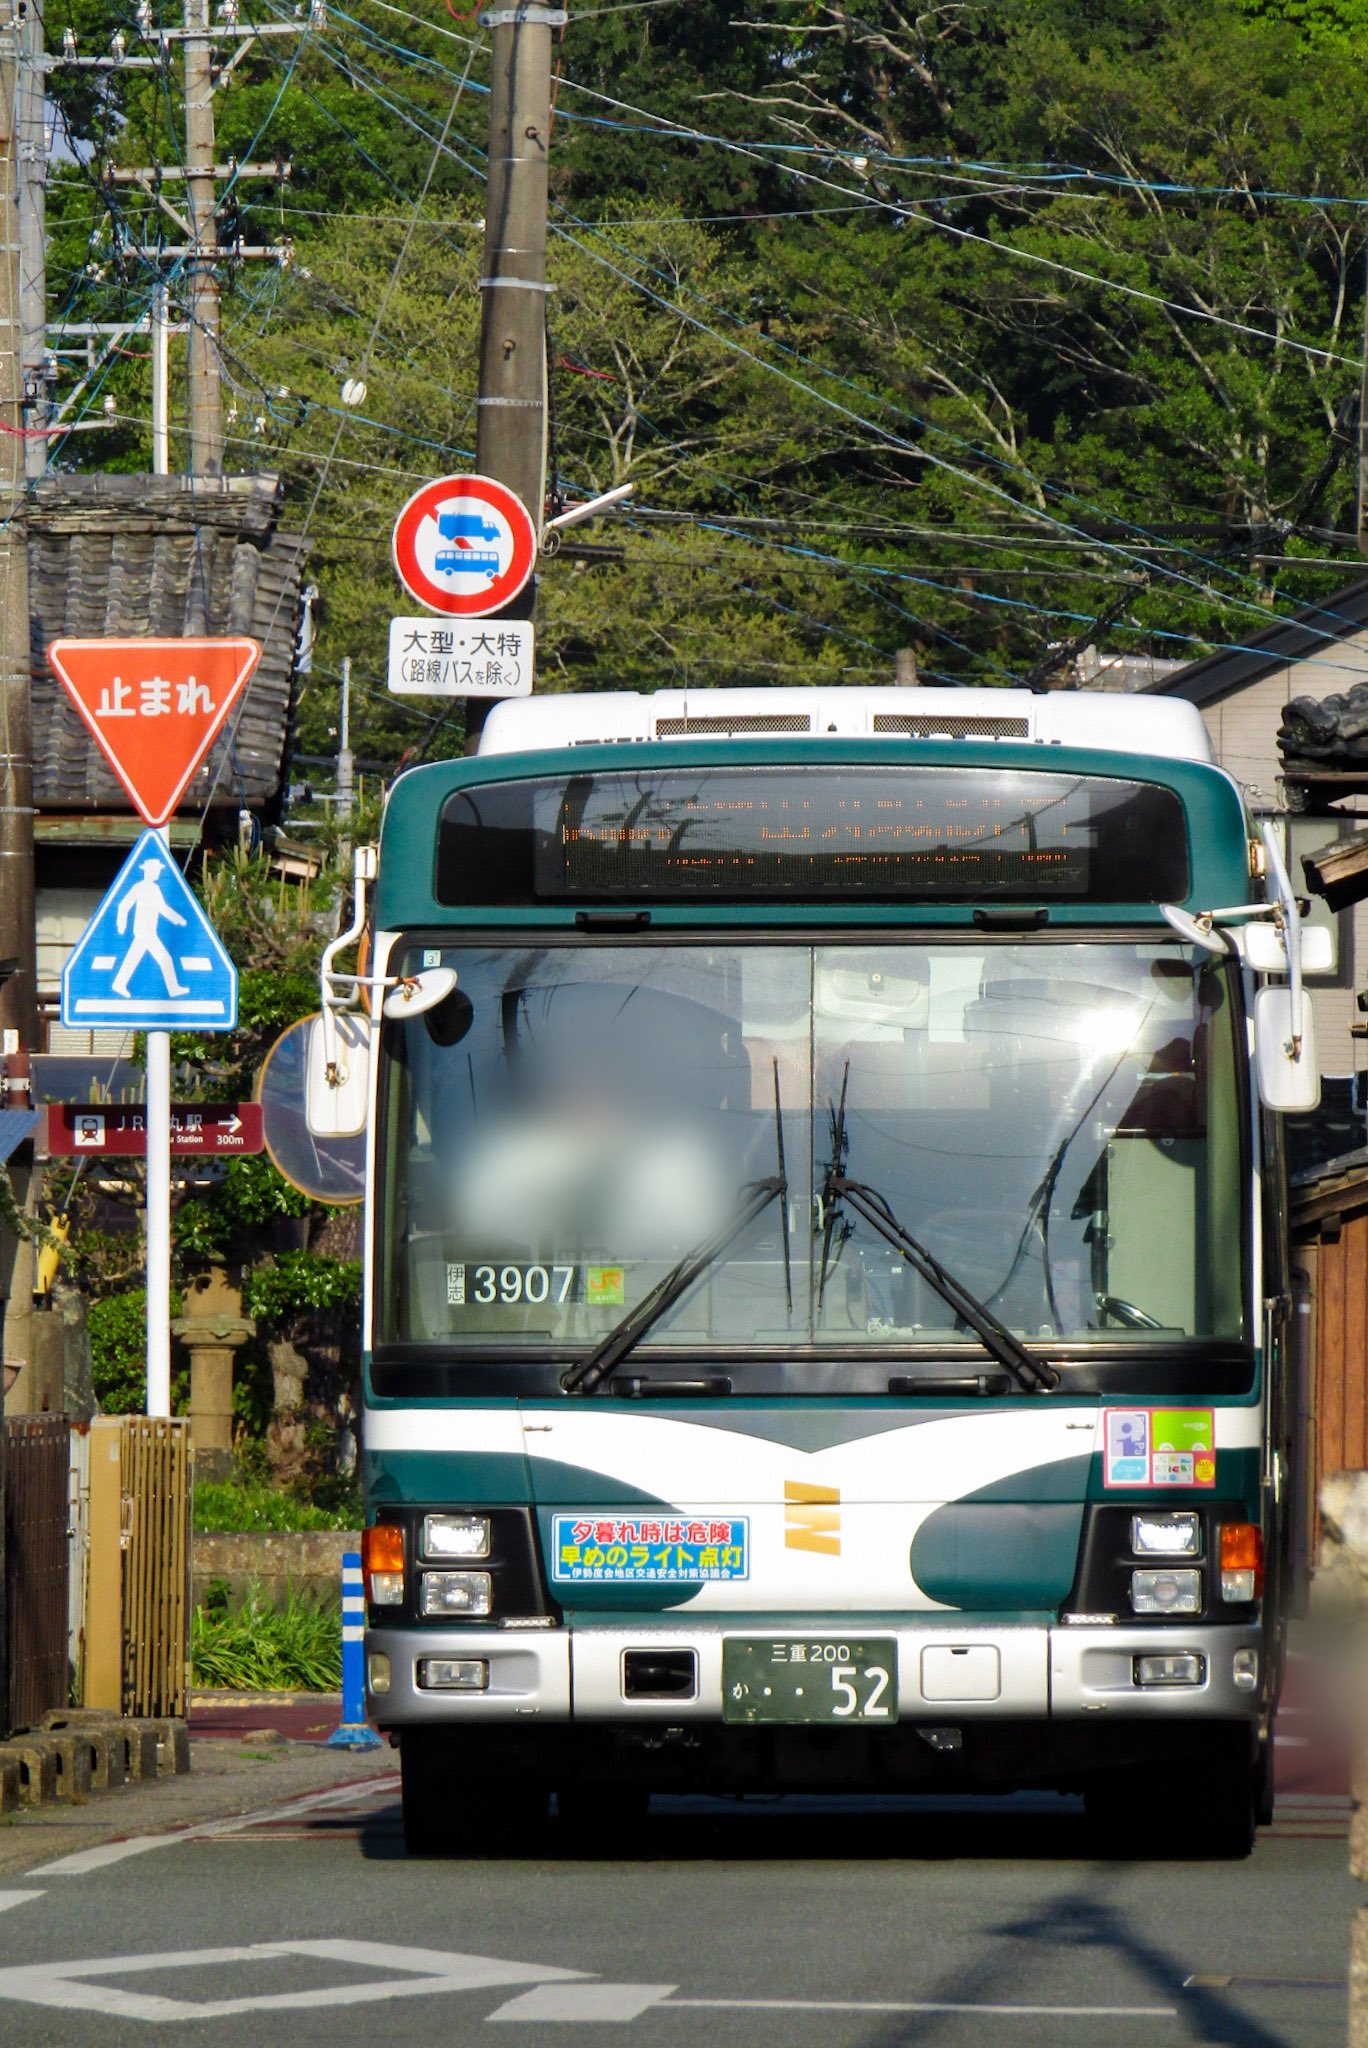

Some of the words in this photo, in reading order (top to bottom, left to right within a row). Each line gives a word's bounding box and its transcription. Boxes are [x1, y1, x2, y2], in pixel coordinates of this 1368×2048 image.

[402, 629, 522, 657] 大型・大特
[95, 676, 215, 717] 止まれ
[177, 1135, 203, 1144] Station
[217, 1135, 244, 1145] 300m
[474, 1266, 574, 1303] 3907
[572, 1521, 732, 1544] 夕暮れ時は危険
[561, 1545, 742, 1567] 早めのライト点灯
